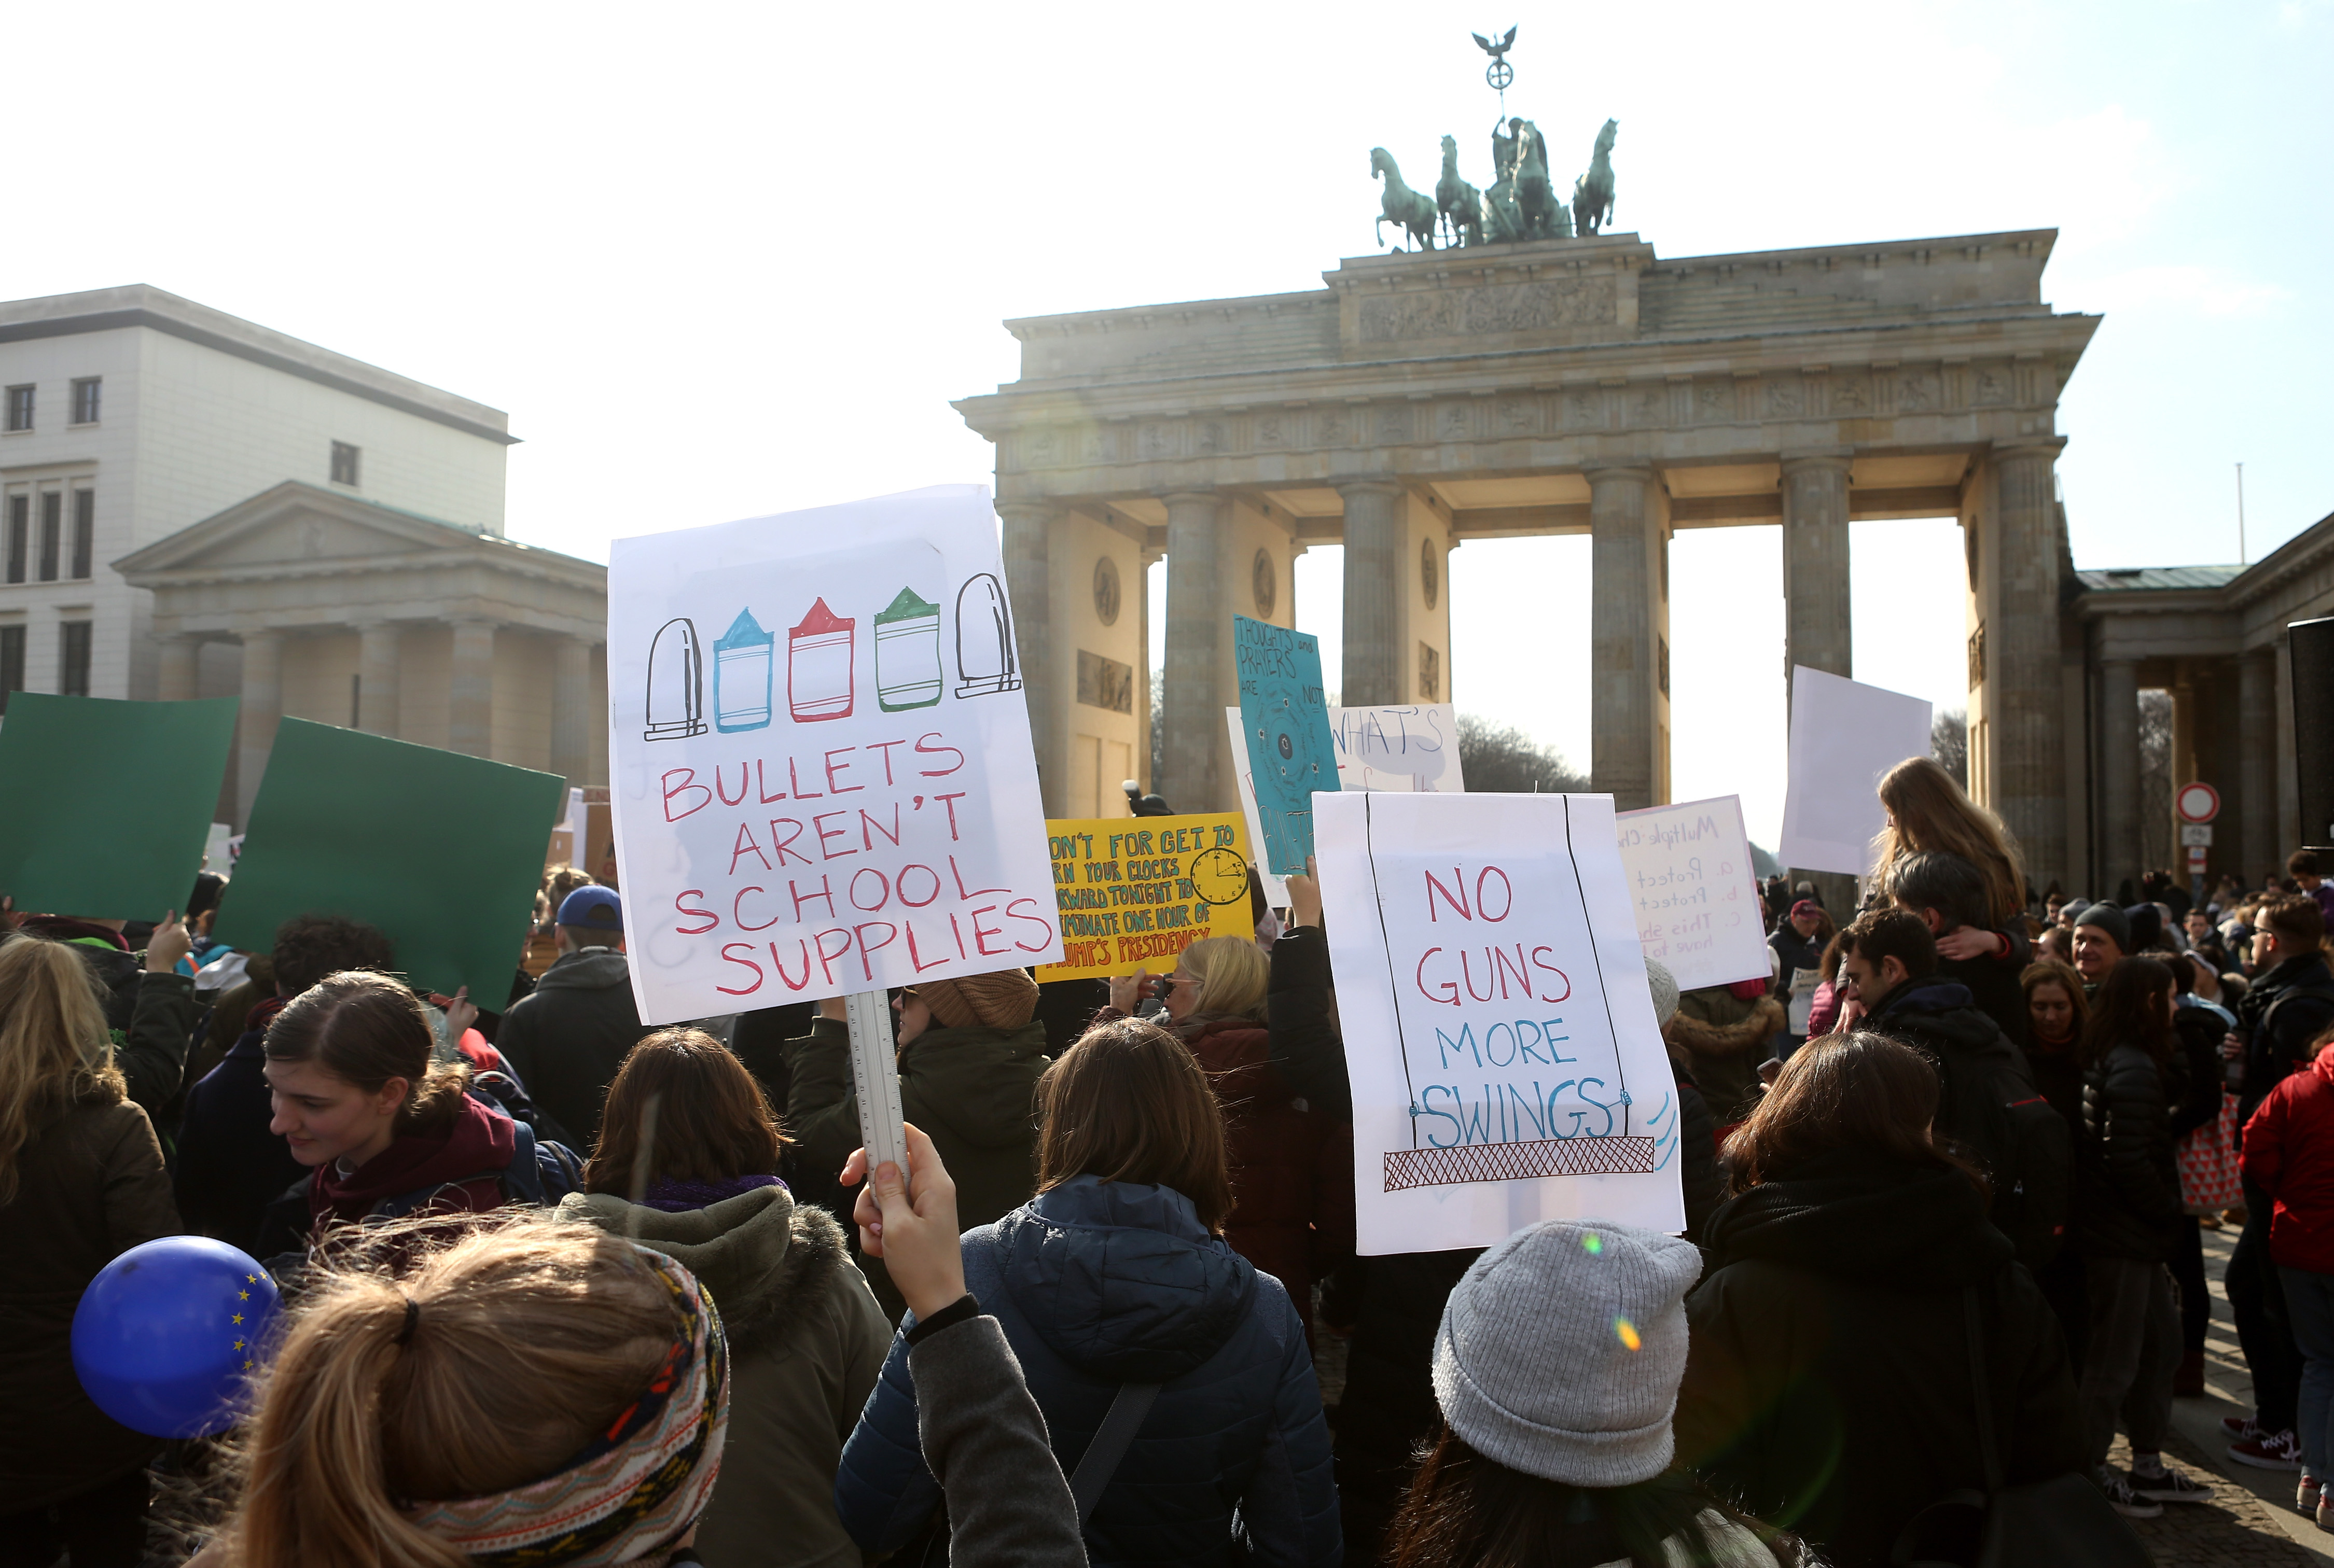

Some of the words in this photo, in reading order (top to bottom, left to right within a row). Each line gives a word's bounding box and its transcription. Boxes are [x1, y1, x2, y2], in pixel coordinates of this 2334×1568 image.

[1235, 618, 1294, 651] THOUGHTS
[1298, 638, 1314, 653] and
[1239, 644, 1296, 679] PRAYERS
[1241, 680, 1258, 695] ARE
[1302, 684, 1324, 708] NOT
[661, 732, 965, 822] BULLETS
[728, 792, 966, 876] AREN'T
[1049, 832, 1093, 860] ON'T
[1213, 824, 1234, 848] TO
[1051, 862, 1075, 884] RN
[1084, 860, 1122, 883] YOUR
[1055, 888, 1108, 911] RWARD
[1107, 881, 1172, 906] TONIGHT
[1175, 877, 1193, 900] TO
[1424, 865, 1512, 922] NO
[675, 855, 1012, 935] SCHOOL
[1123, 908, 1155, 933] ONE
[1156, 905, 1192, 930] HOUR
[1194, 902, 1211, 923] OF
[715, 897, 1053, 996] SUPPLIES
[1046, 939, 1112, 969] UMP'S
[1416, 942, 1572, 1006] GUNS
[1435, 1017, 1577, 1070] MORE
[1421, 1077, 1614, 1149] SWINGS
